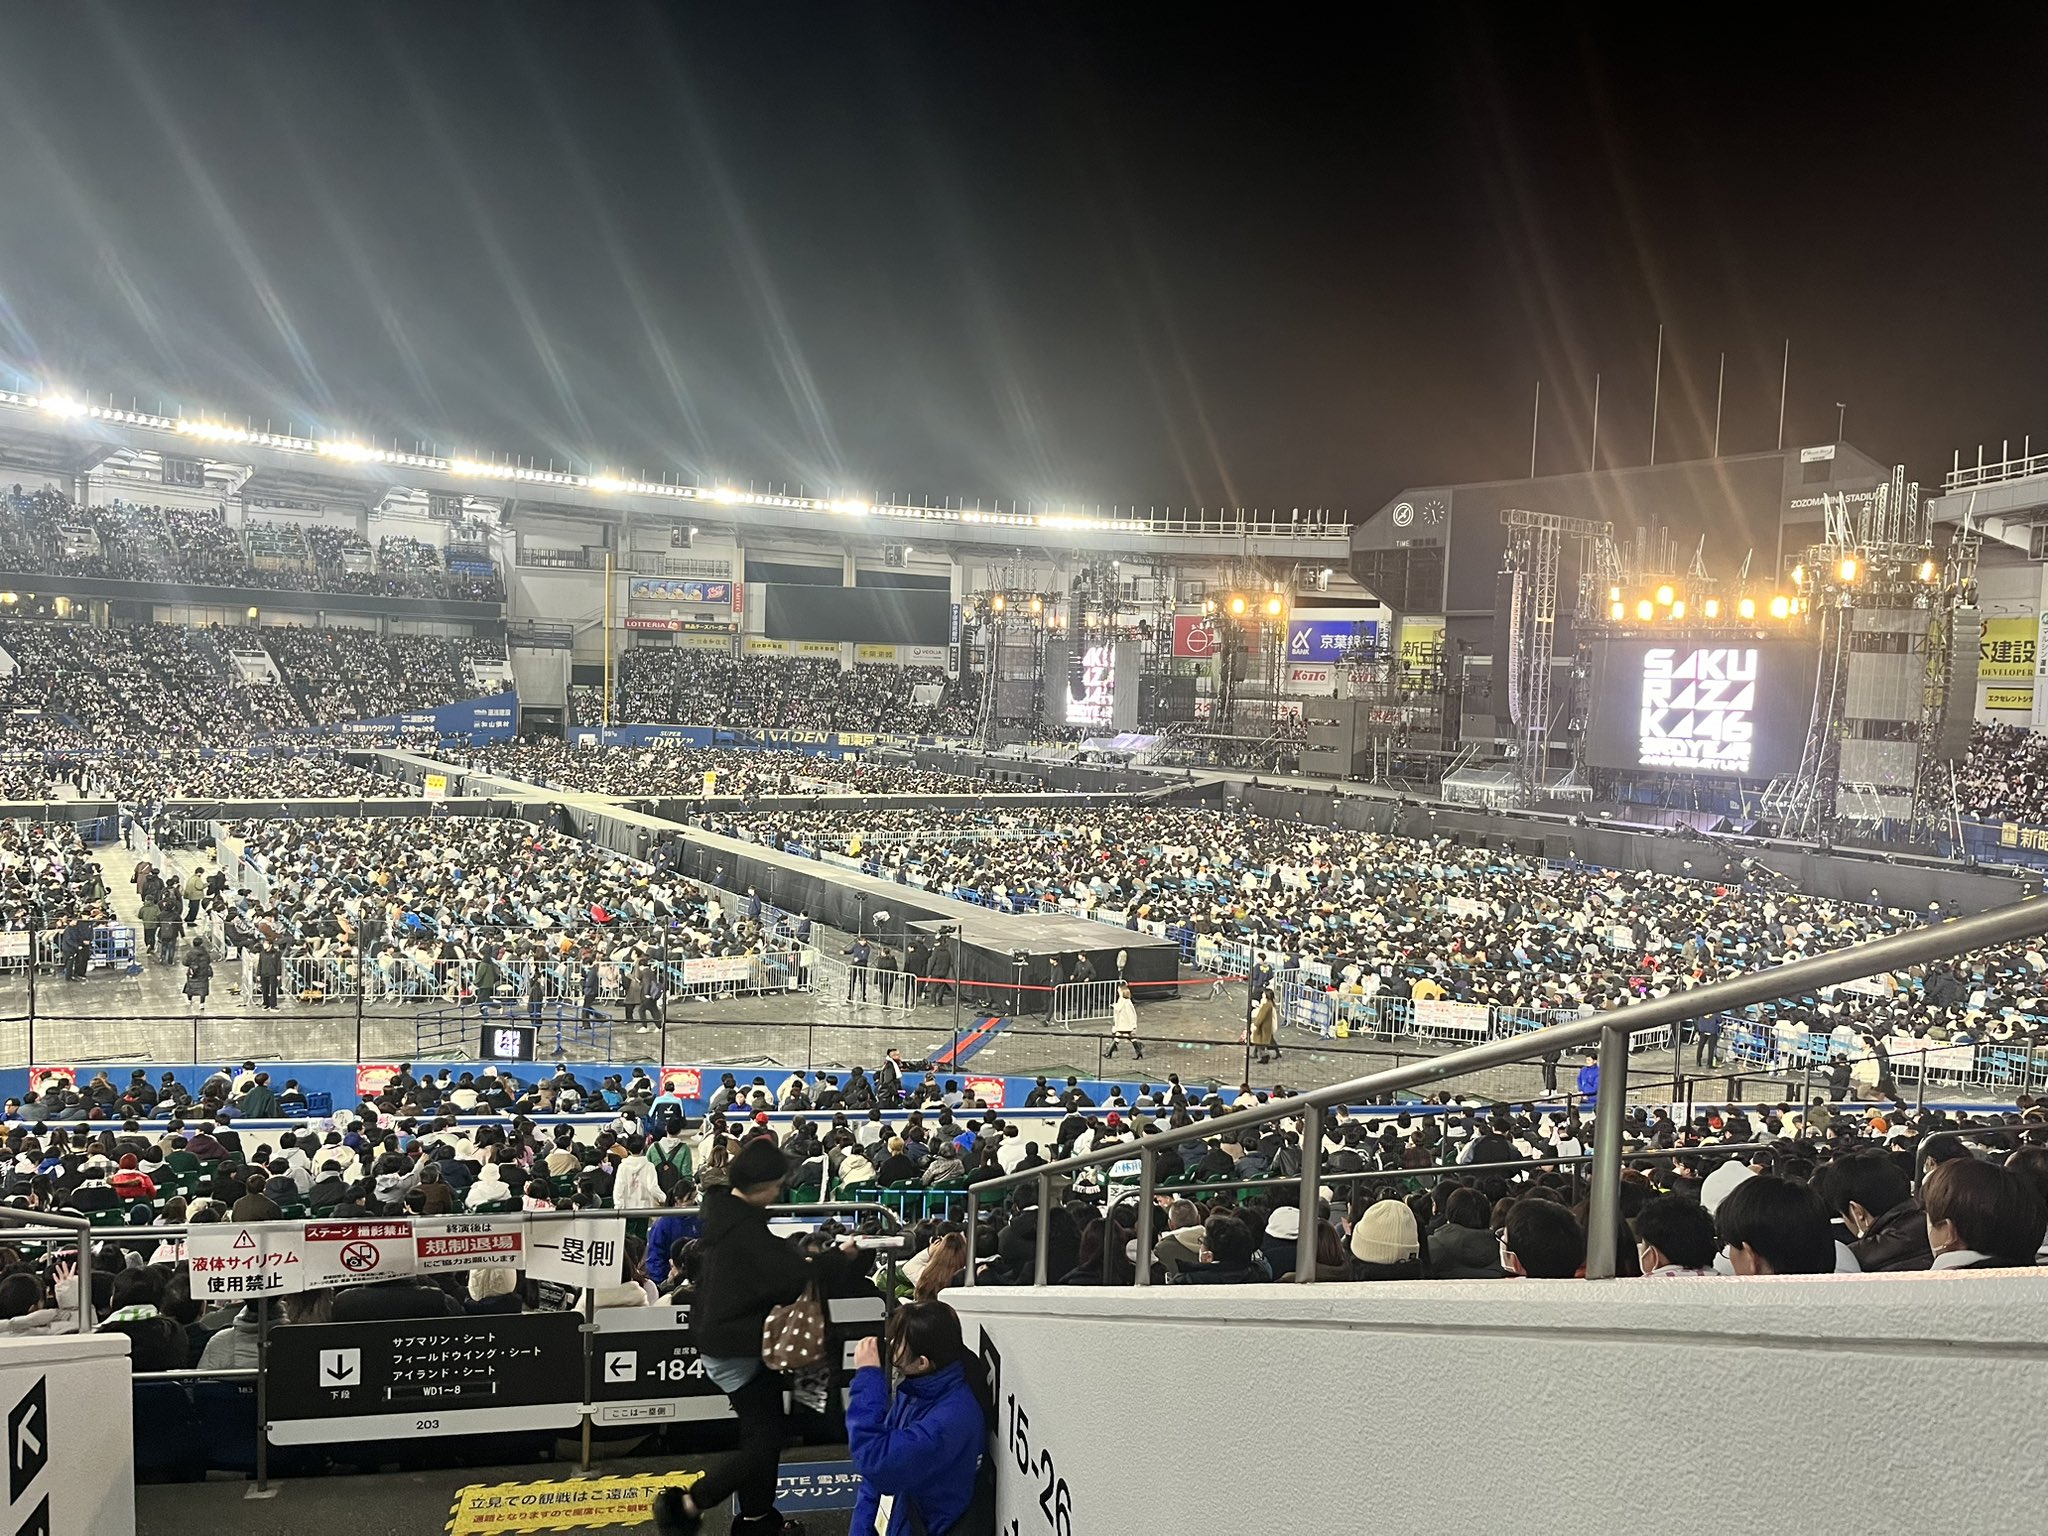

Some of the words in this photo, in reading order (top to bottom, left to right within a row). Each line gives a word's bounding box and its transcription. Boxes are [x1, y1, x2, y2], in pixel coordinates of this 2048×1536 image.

[626, 620, 666, 629] LOTTERIA
[1403, 641, 1434, 657] 新日
[1643, 648, 1758, 680] SAKU
[1981, 668, 2034, 677] DEVELOPER
[1642, 679, 1755, 710] RAZA
[1640, 707, 1753, 742] KA46
[307, 1226, 353, 1238] ステージ
[357, 1224, 410, 1237] 撮影禁止
[446, 1223, 492, 1233] 終演後は
[425, 1235, 514, 1254] 規制退場
[533, 1237, 615, 1267] 一塁側
[192, 1251, 299, 1272] 液体サイリウム
[423, 1255, 517, 1268] にご協力お願いします
[207, 1272, 284, 1293] 使用禁止
[392, 1332, 496, 1348] サブマリン・シート
[392, 1346, 542, 1364] フィールドウイング・シート
[392, 1365, 496, 1381] アイランド・シート
[646, 1358, 705, 1381] -184
[330, 1390, 351, 1400] 下段
[612, 1406, 667, 1418] ここは一塁側
[416, 1419, 440, 1430] 203
[776, 1476, 811, 1486] TTE
